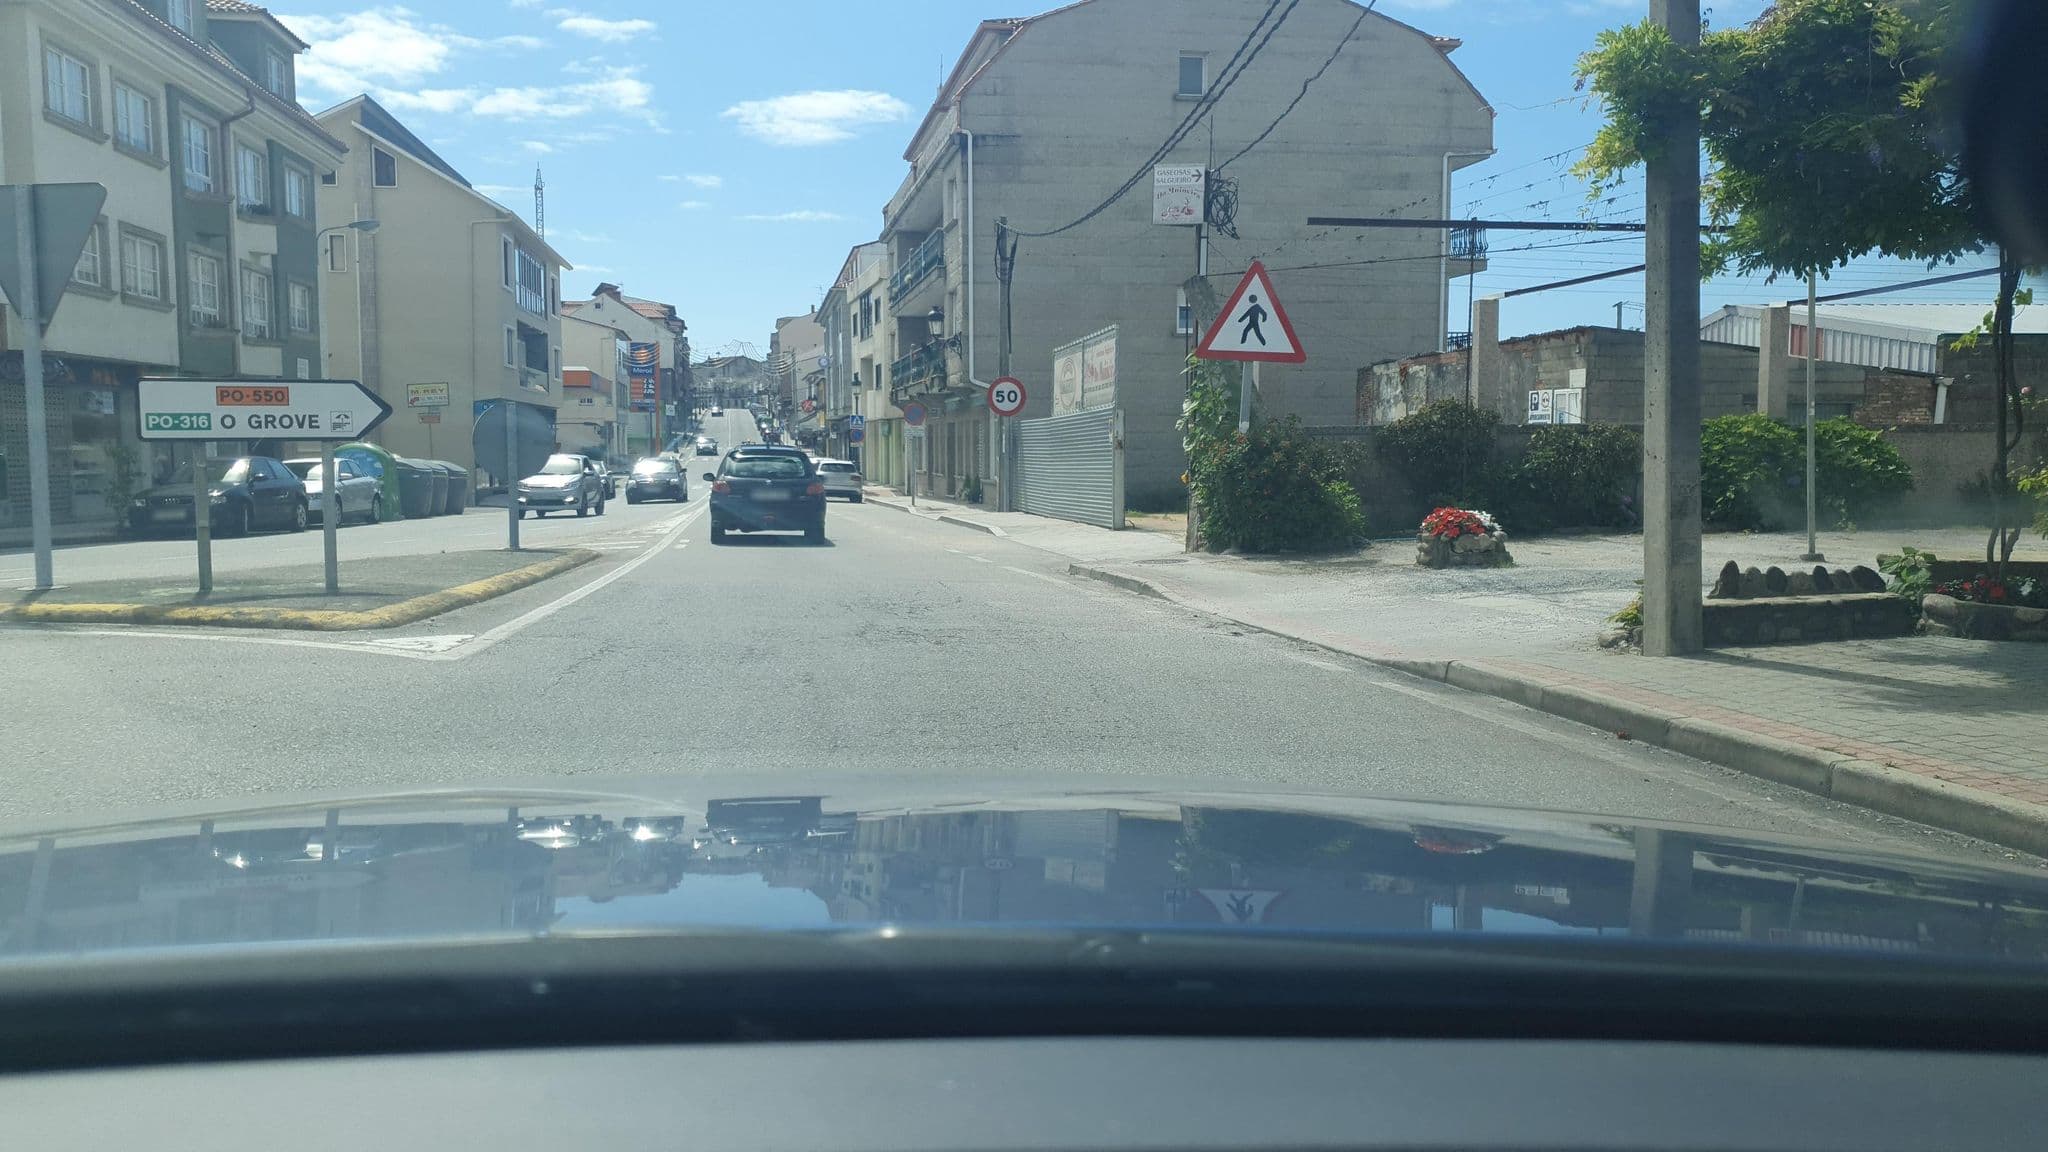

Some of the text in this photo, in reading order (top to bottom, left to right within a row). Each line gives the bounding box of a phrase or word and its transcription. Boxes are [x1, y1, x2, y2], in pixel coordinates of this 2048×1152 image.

[219, 389, 286, 402] PO-550
[995, 390, 1018, 403] 50
[149, 415, 209, 428] PO-316
[220, 414, 320, 429] O GROVE
